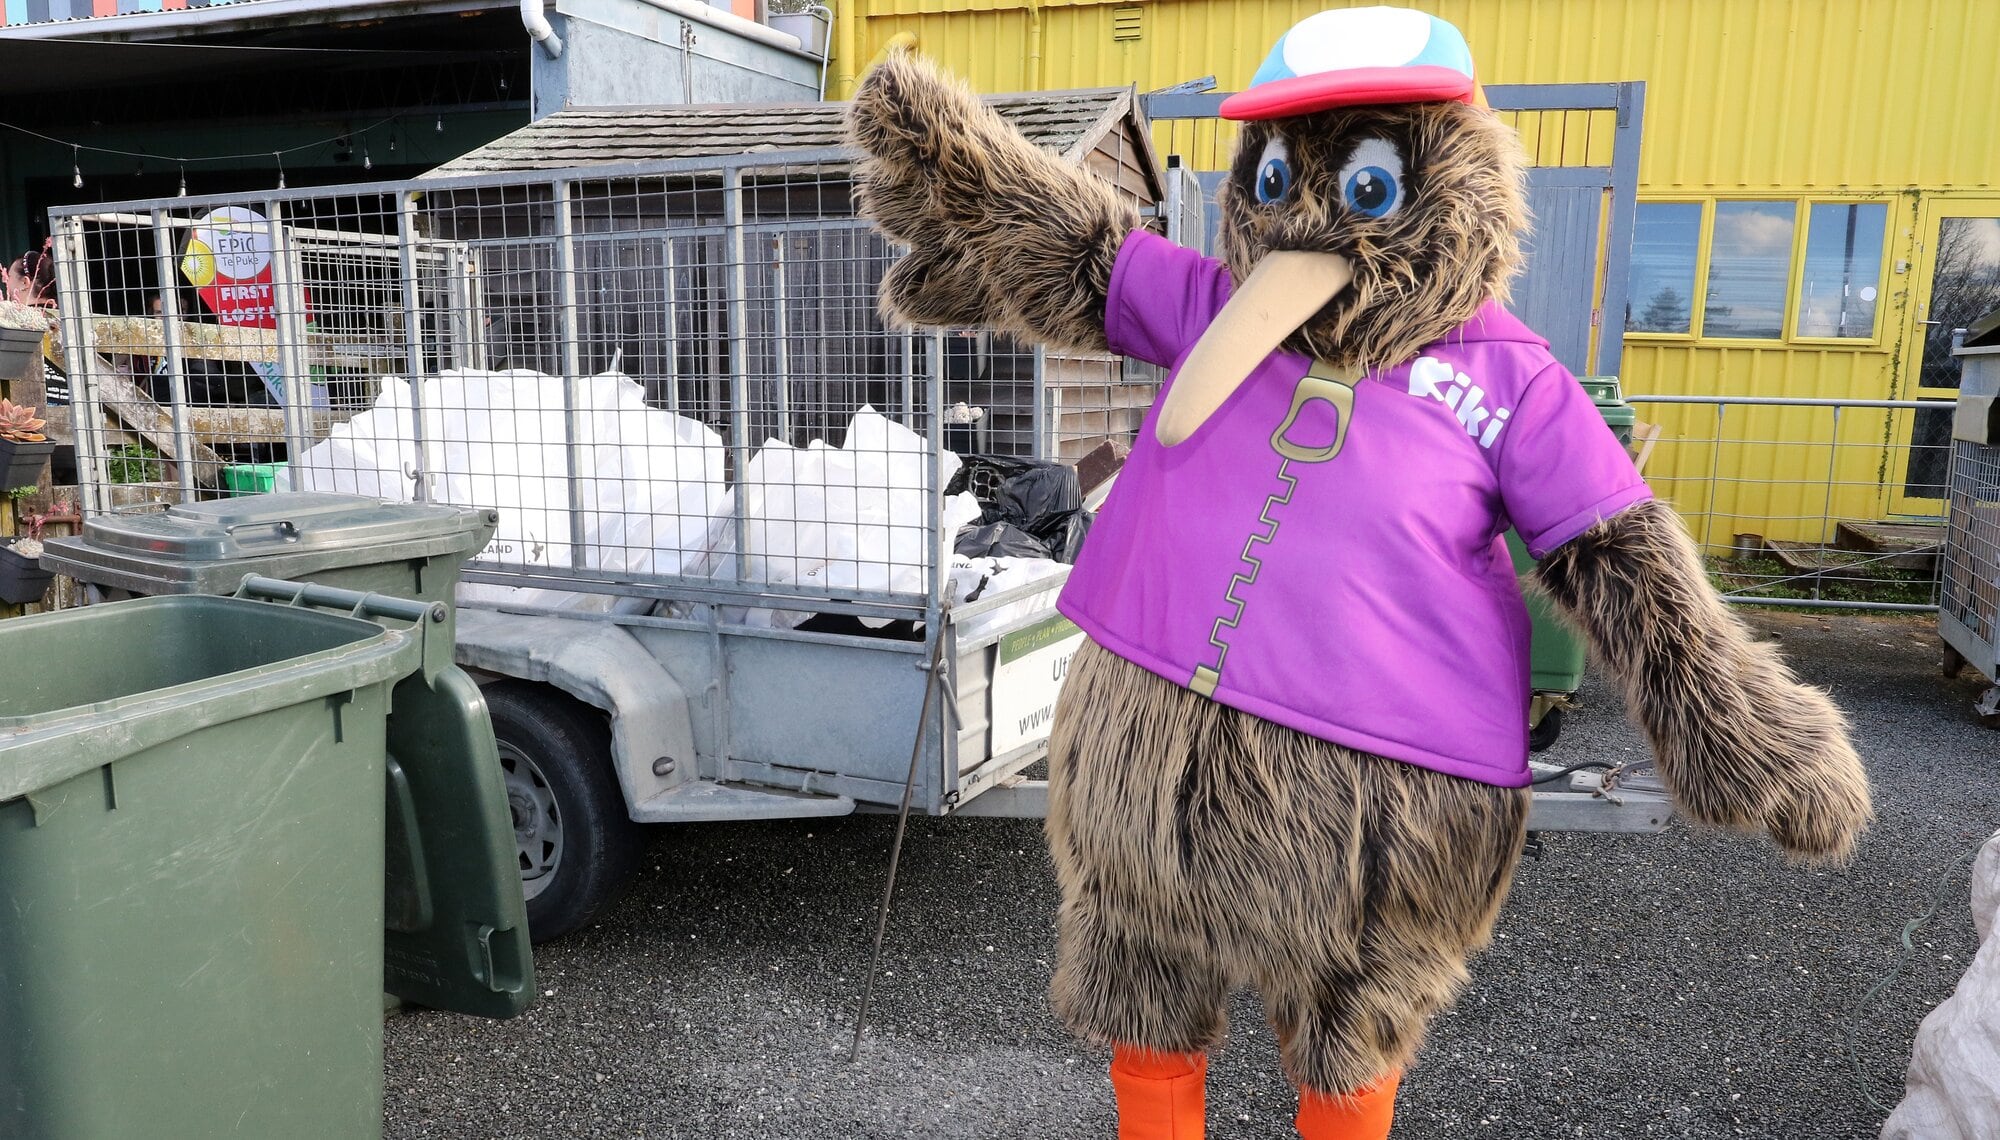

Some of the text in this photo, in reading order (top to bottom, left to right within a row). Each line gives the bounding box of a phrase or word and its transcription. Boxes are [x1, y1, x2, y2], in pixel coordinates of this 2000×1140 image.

[221, 256, 259, 266] Te Puke
[220, 285, 270, 301] FIRST
[221, 307, 266, 323] LOST
[1408, 356, 1510, 449] Kiki
[1011, 633, 1032, 653] PEOPLE
[1035, 626, 1051, 642] PLAN
